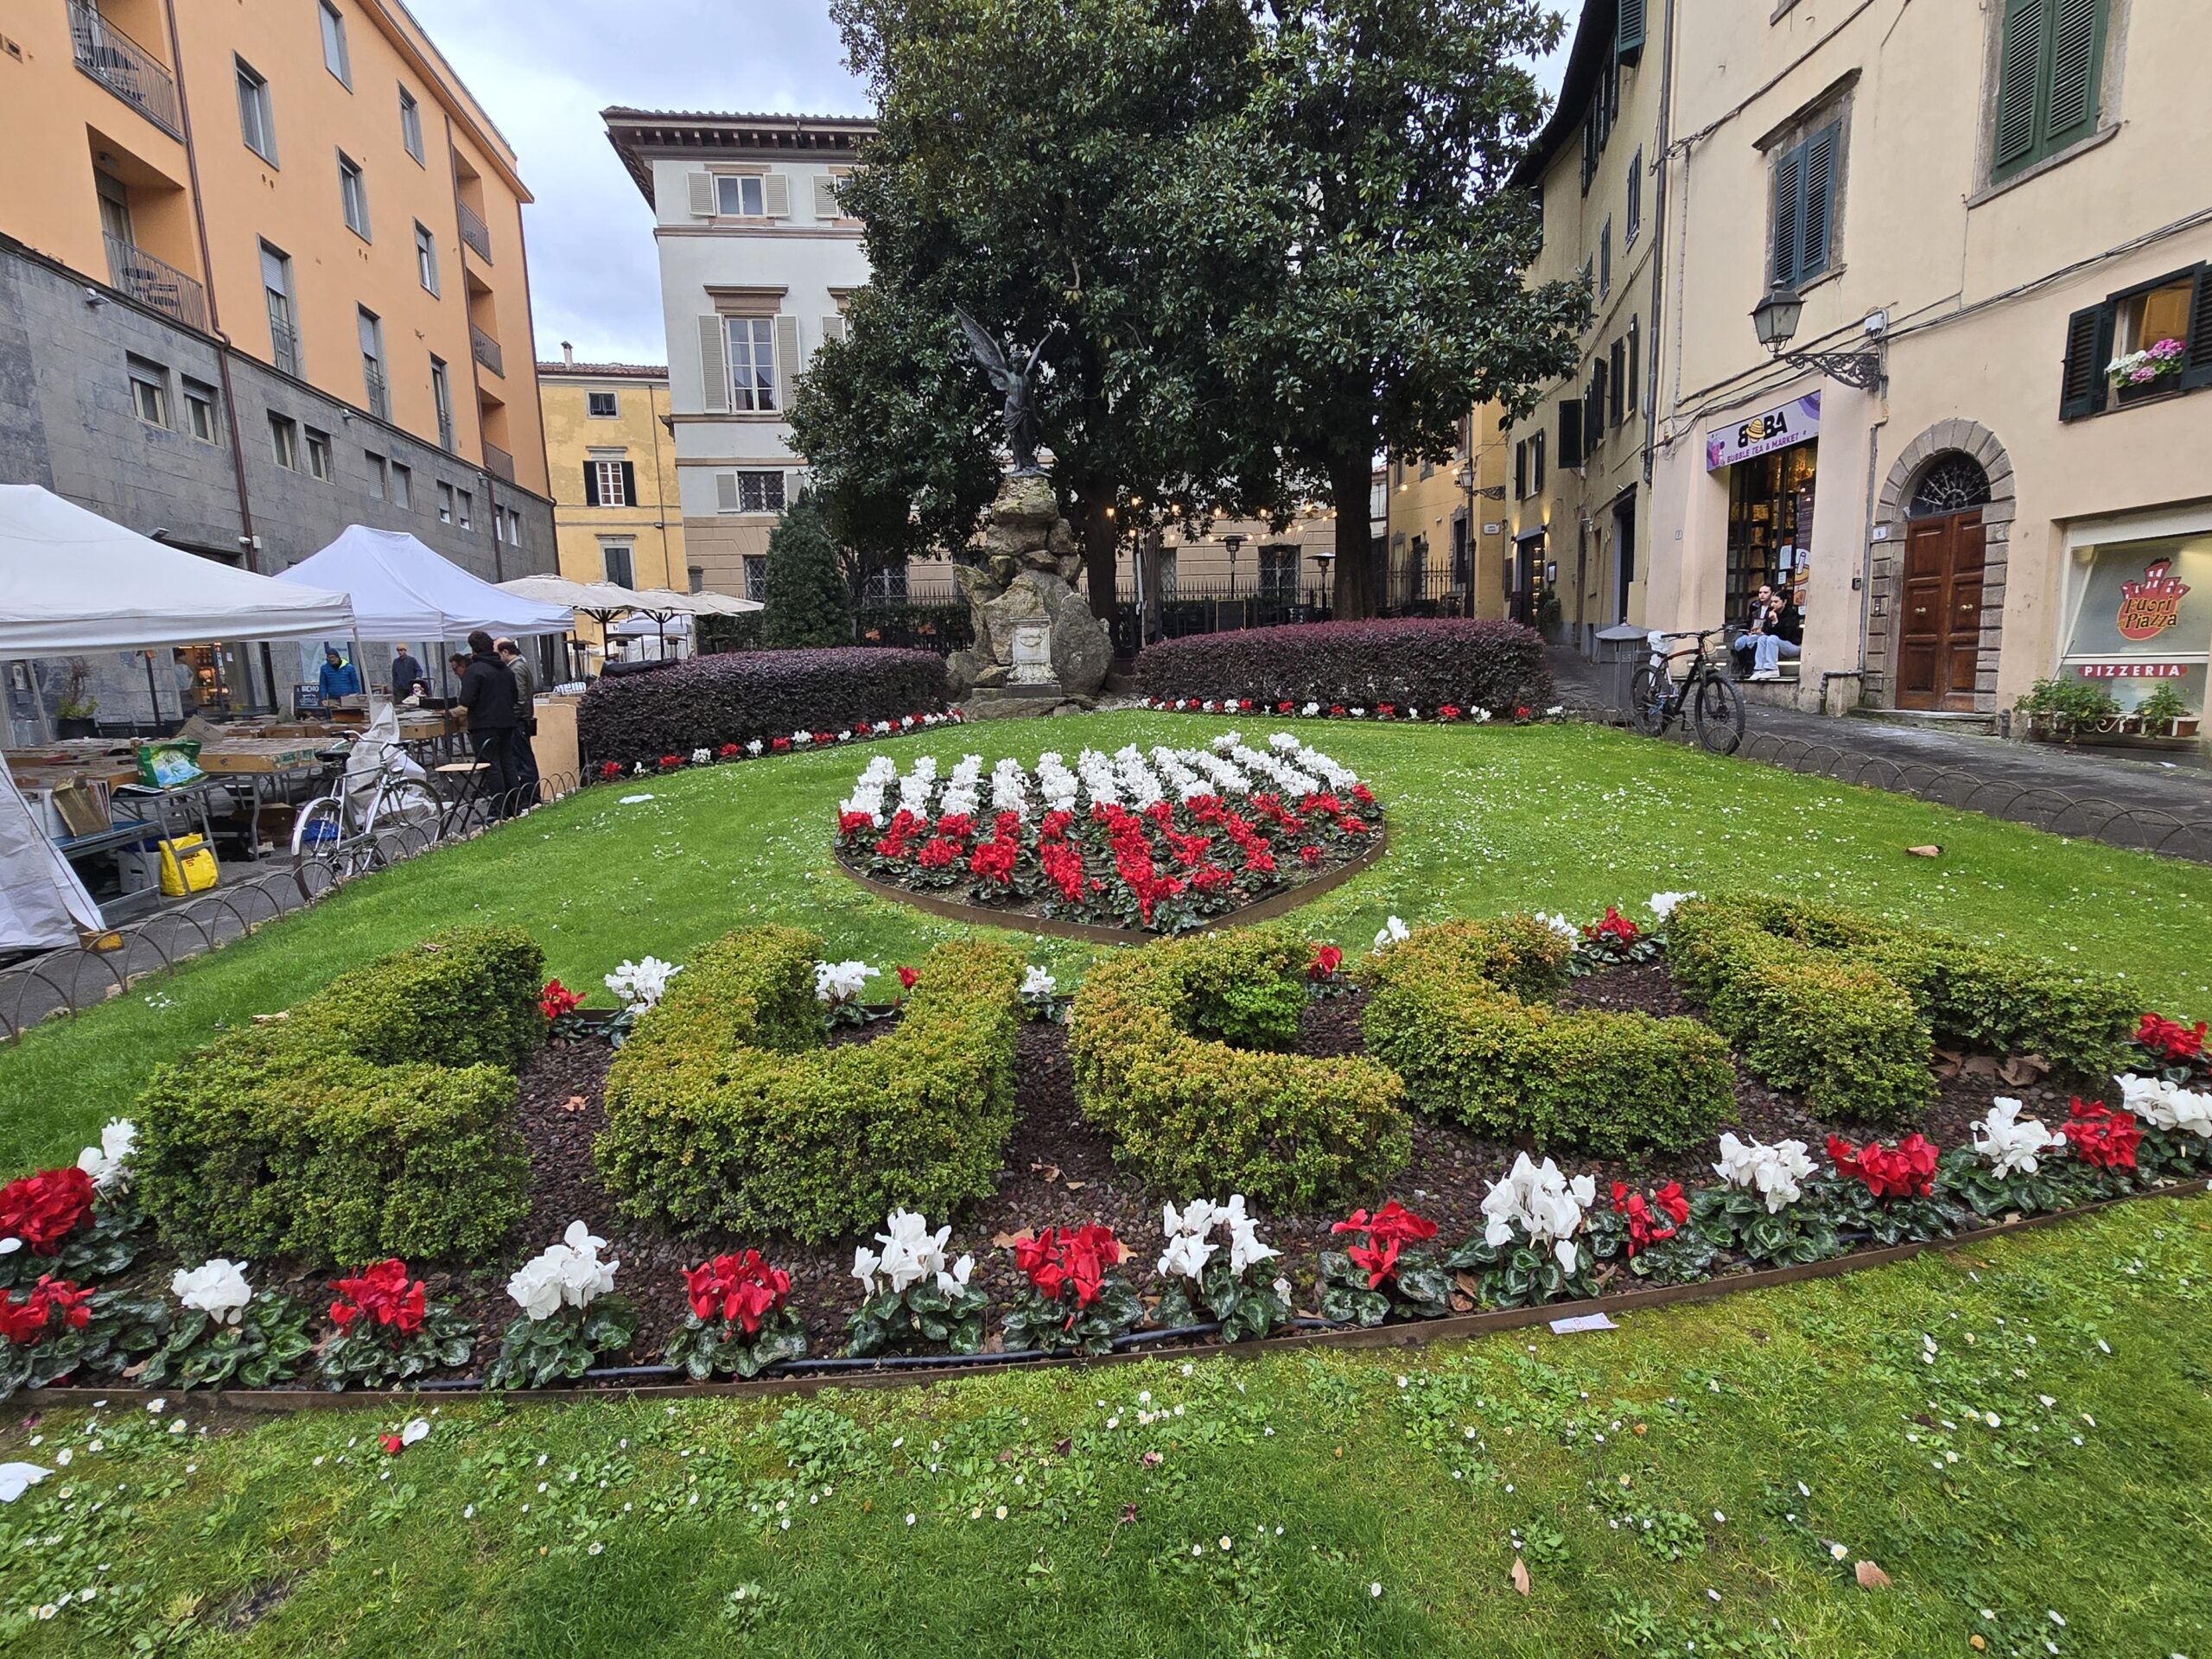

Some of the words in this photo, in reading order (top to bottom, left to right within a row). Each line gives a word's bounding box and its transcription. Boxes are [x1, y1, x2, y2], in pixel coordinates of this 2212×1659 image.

[1726, 449, 1750, 463] BUBBLE
[1751, 445, 1764, 455] TEA
[1771, 432, 1799, 448] MARKET
[2125, 595, 2173, 614] Fuori
[2125, 613, 2177, 629] Piazza
[2084, 664, 2180, 677] PIZZERIA
